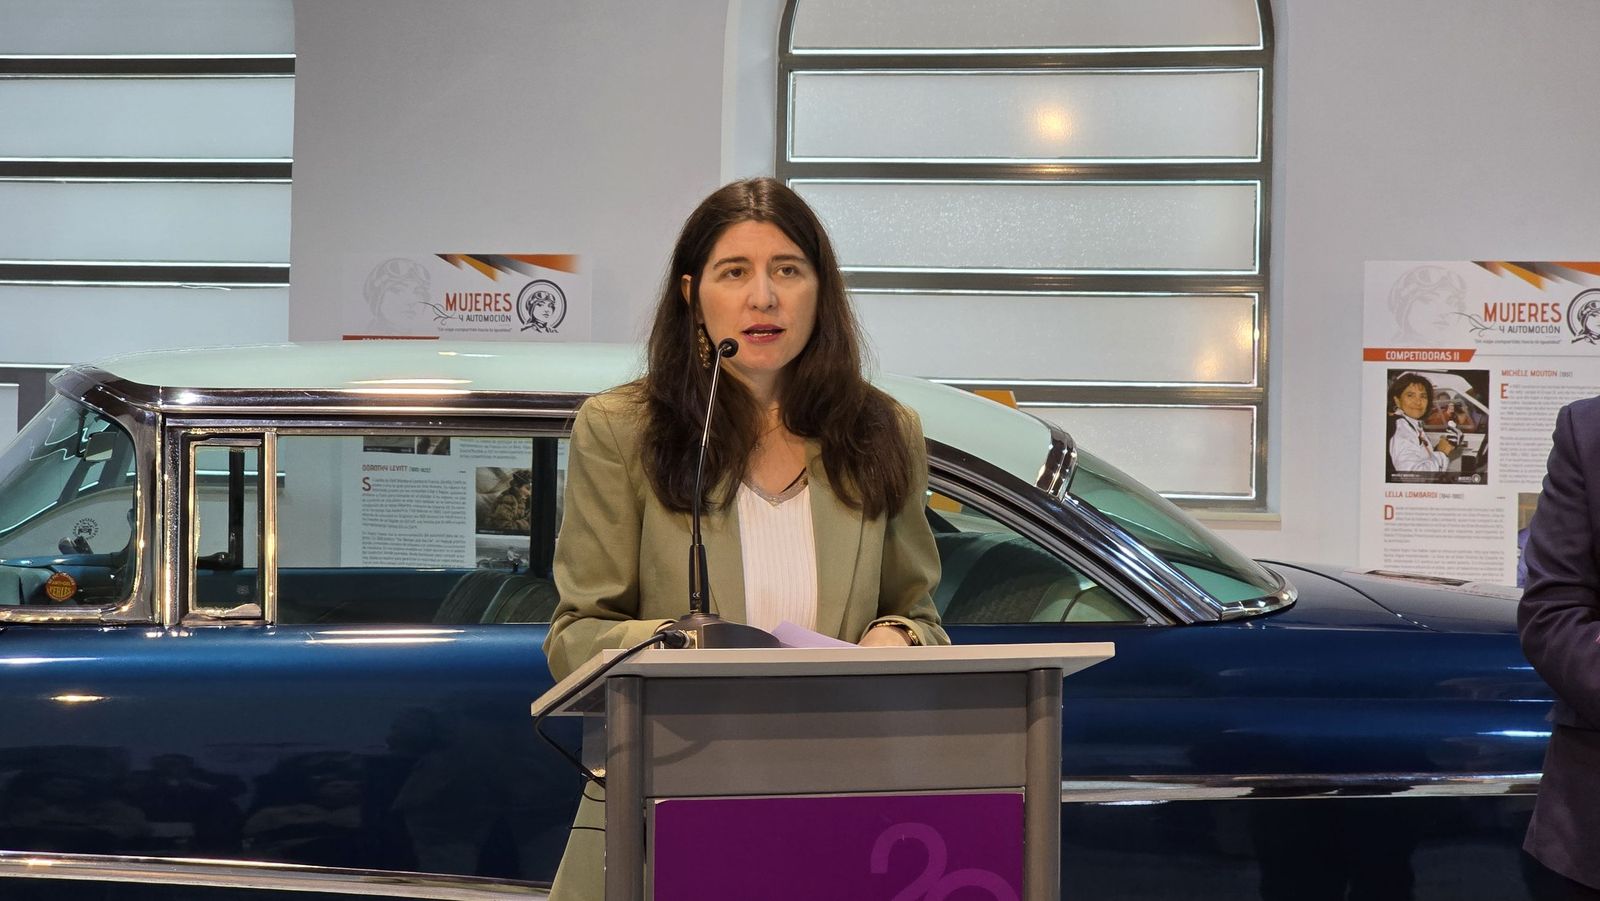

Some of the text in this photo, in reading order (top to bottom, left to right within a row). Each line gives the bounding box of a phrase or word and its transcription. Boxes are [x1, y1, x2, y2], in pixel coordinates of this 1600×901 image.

[445, 293, 513, 312] MUJERES
[1484, 302, 1562, 323] MUJERES
[466, 313, 511, 322] AUTOMOCIÓN
[1508, 325, 1560, 334] AUTOMOCIÓN
[1385, 351, 1452, 360] COMPETIDORAS
